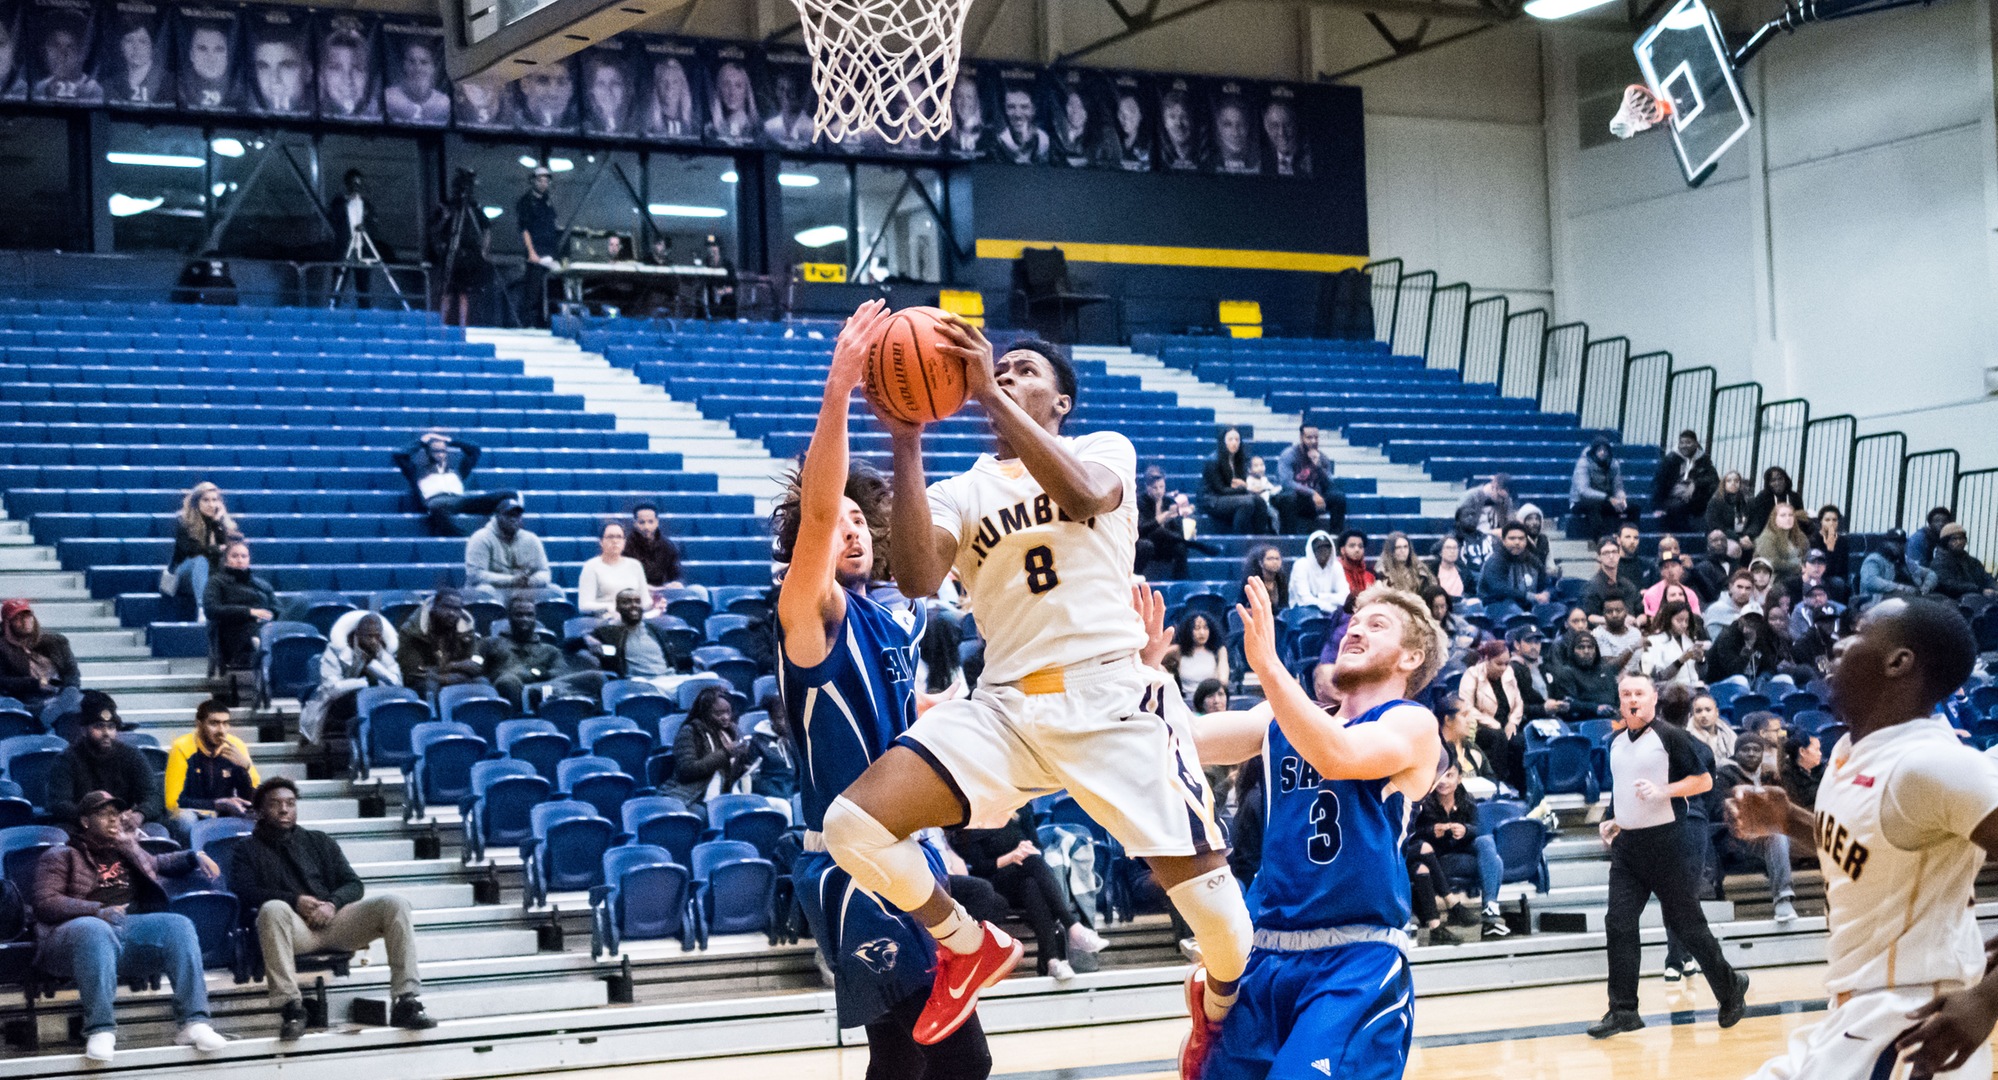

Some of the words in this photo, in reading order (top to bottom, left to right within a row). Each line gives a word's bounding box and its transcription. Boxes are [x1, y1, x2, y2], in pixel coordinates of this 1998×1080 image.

[130, 85, 148, 102] 21
[201, 89, 222, 106] 29
[892, 342, 919, 412] EVOLUTION
[1024, 545, 1059, 595] 8
[1280, 755, 1325, 794] SA
[1307, 789, 1342, 865] 3
